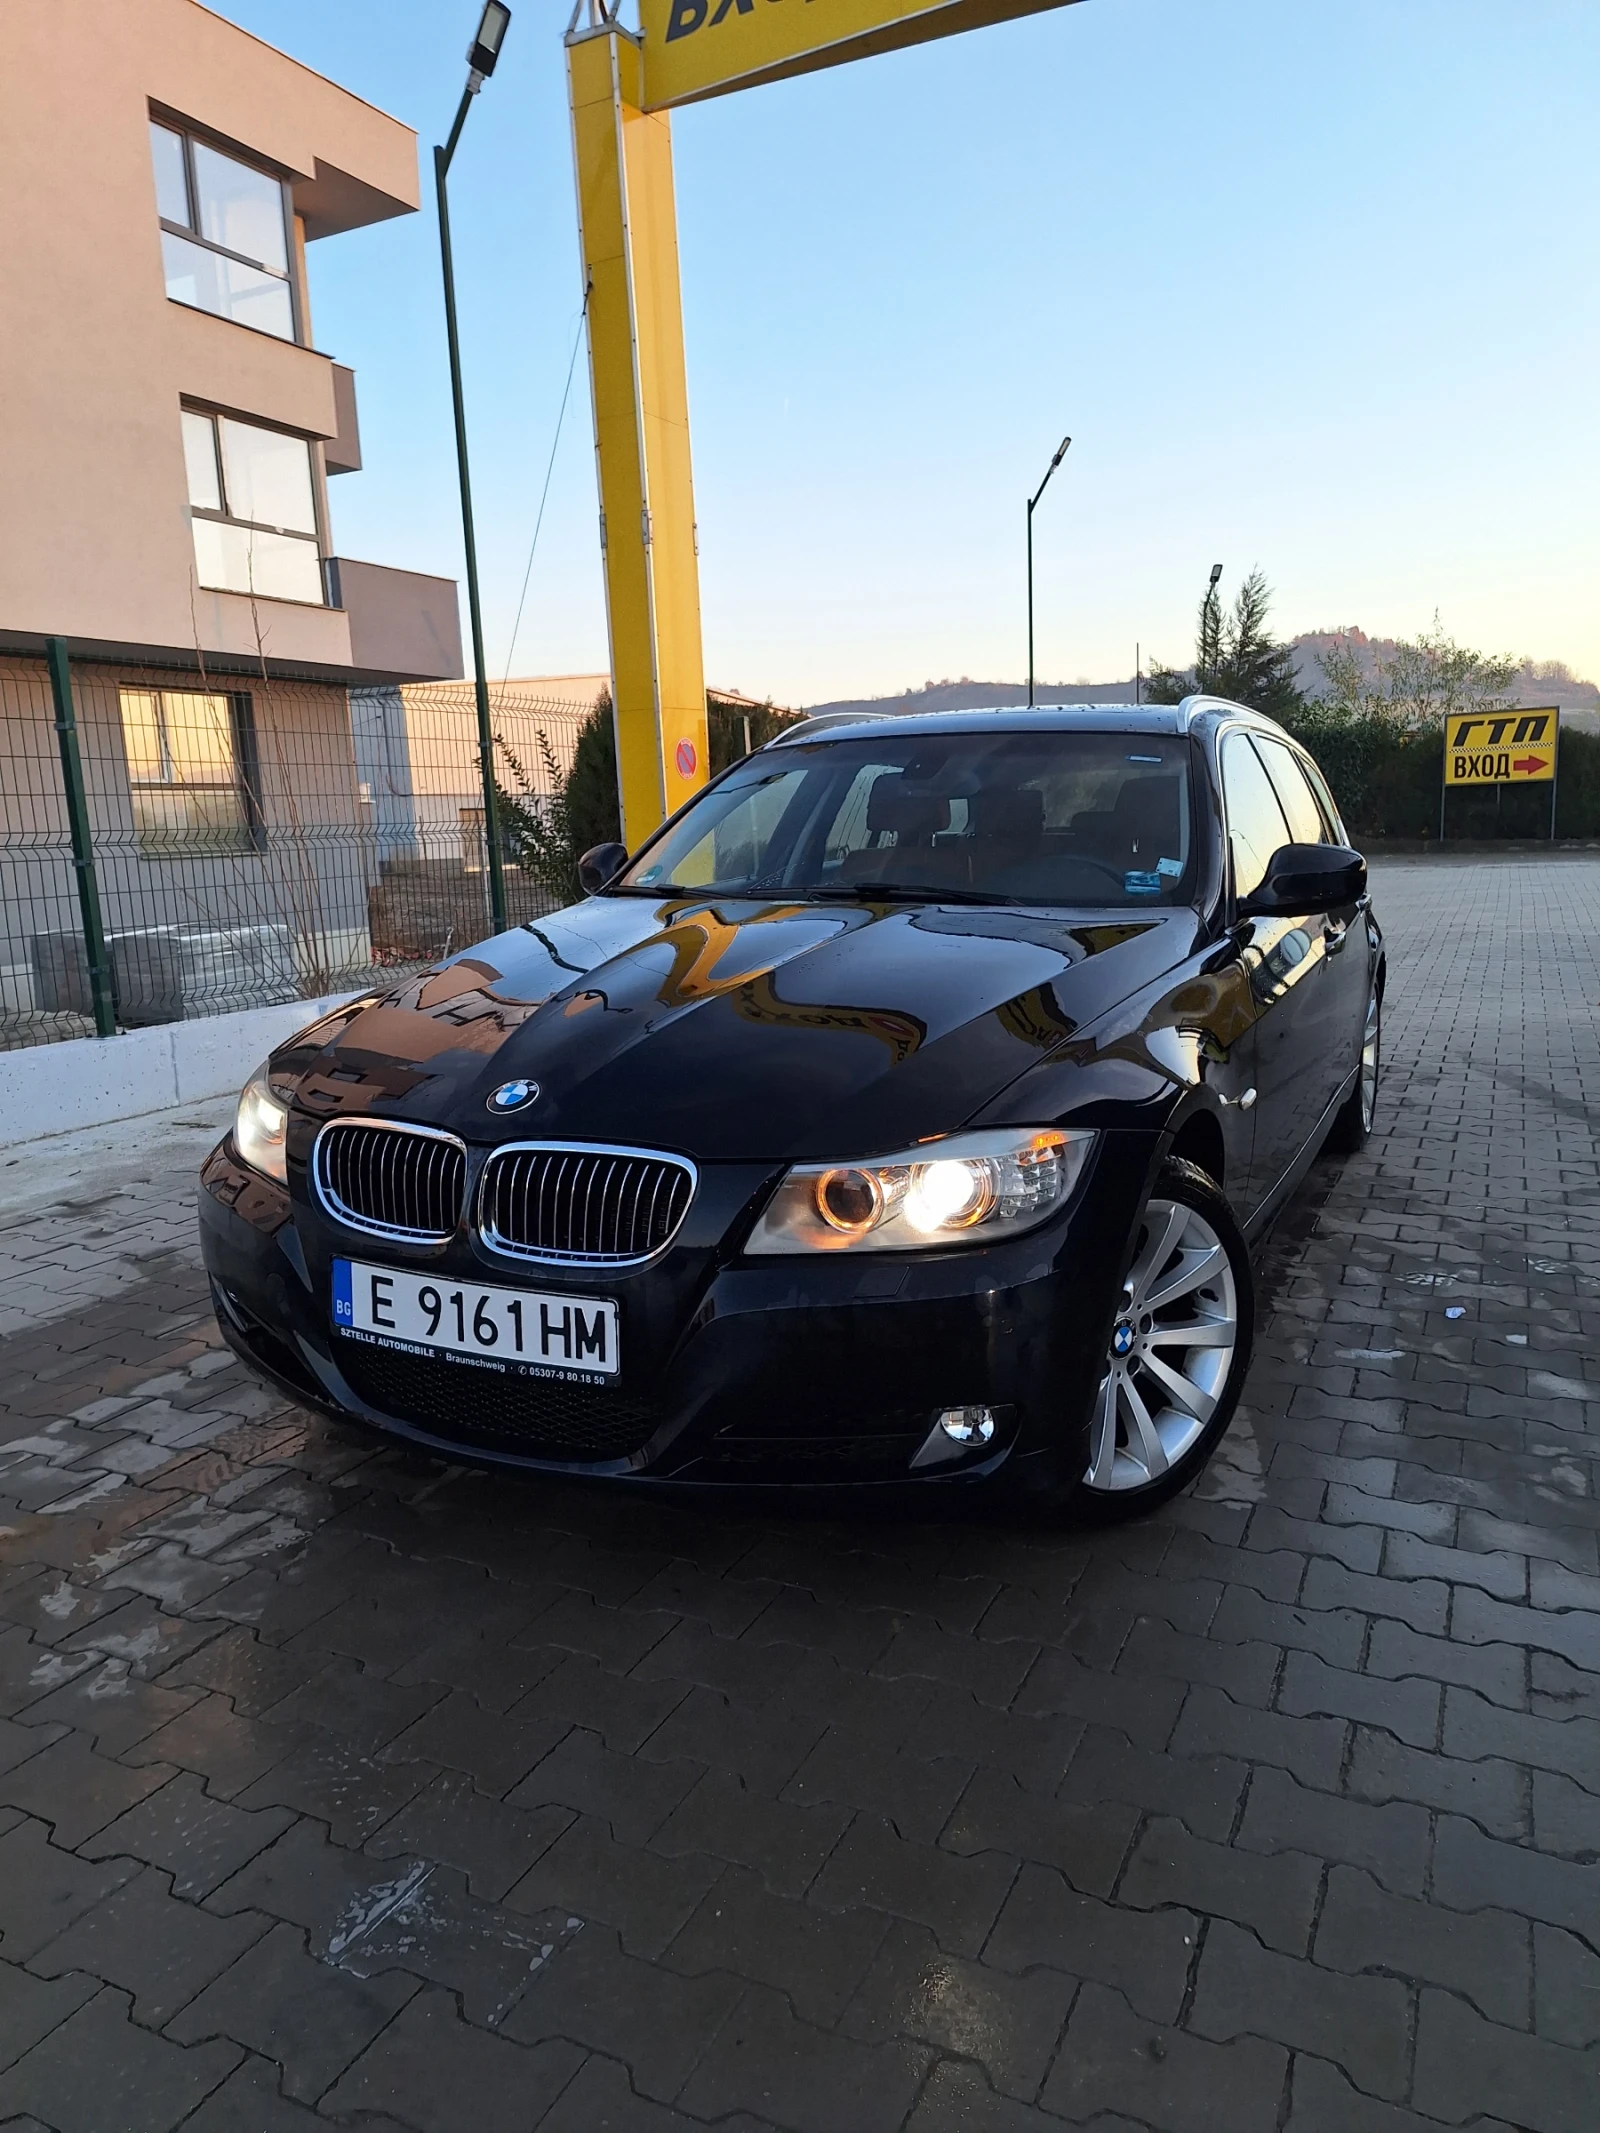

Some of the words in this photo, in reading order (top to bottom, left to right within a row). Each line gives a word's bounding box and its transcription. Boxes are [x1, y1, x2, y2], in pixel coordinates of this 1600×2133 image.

[1452, 715, 1550, 747] ГТП
[1454, 753, 1510, 779] ВХОД
[336, 1299, 351, 1317] BG
[371, 1274, 396, 1329] E
[418, 1285, 523, 1352] 9161
[540, 1303, 606, 1363] HM
[377, 1336, 435, 1358] AUTOMOBILE
[446, 1352, 506, 1373] Braunschweig
